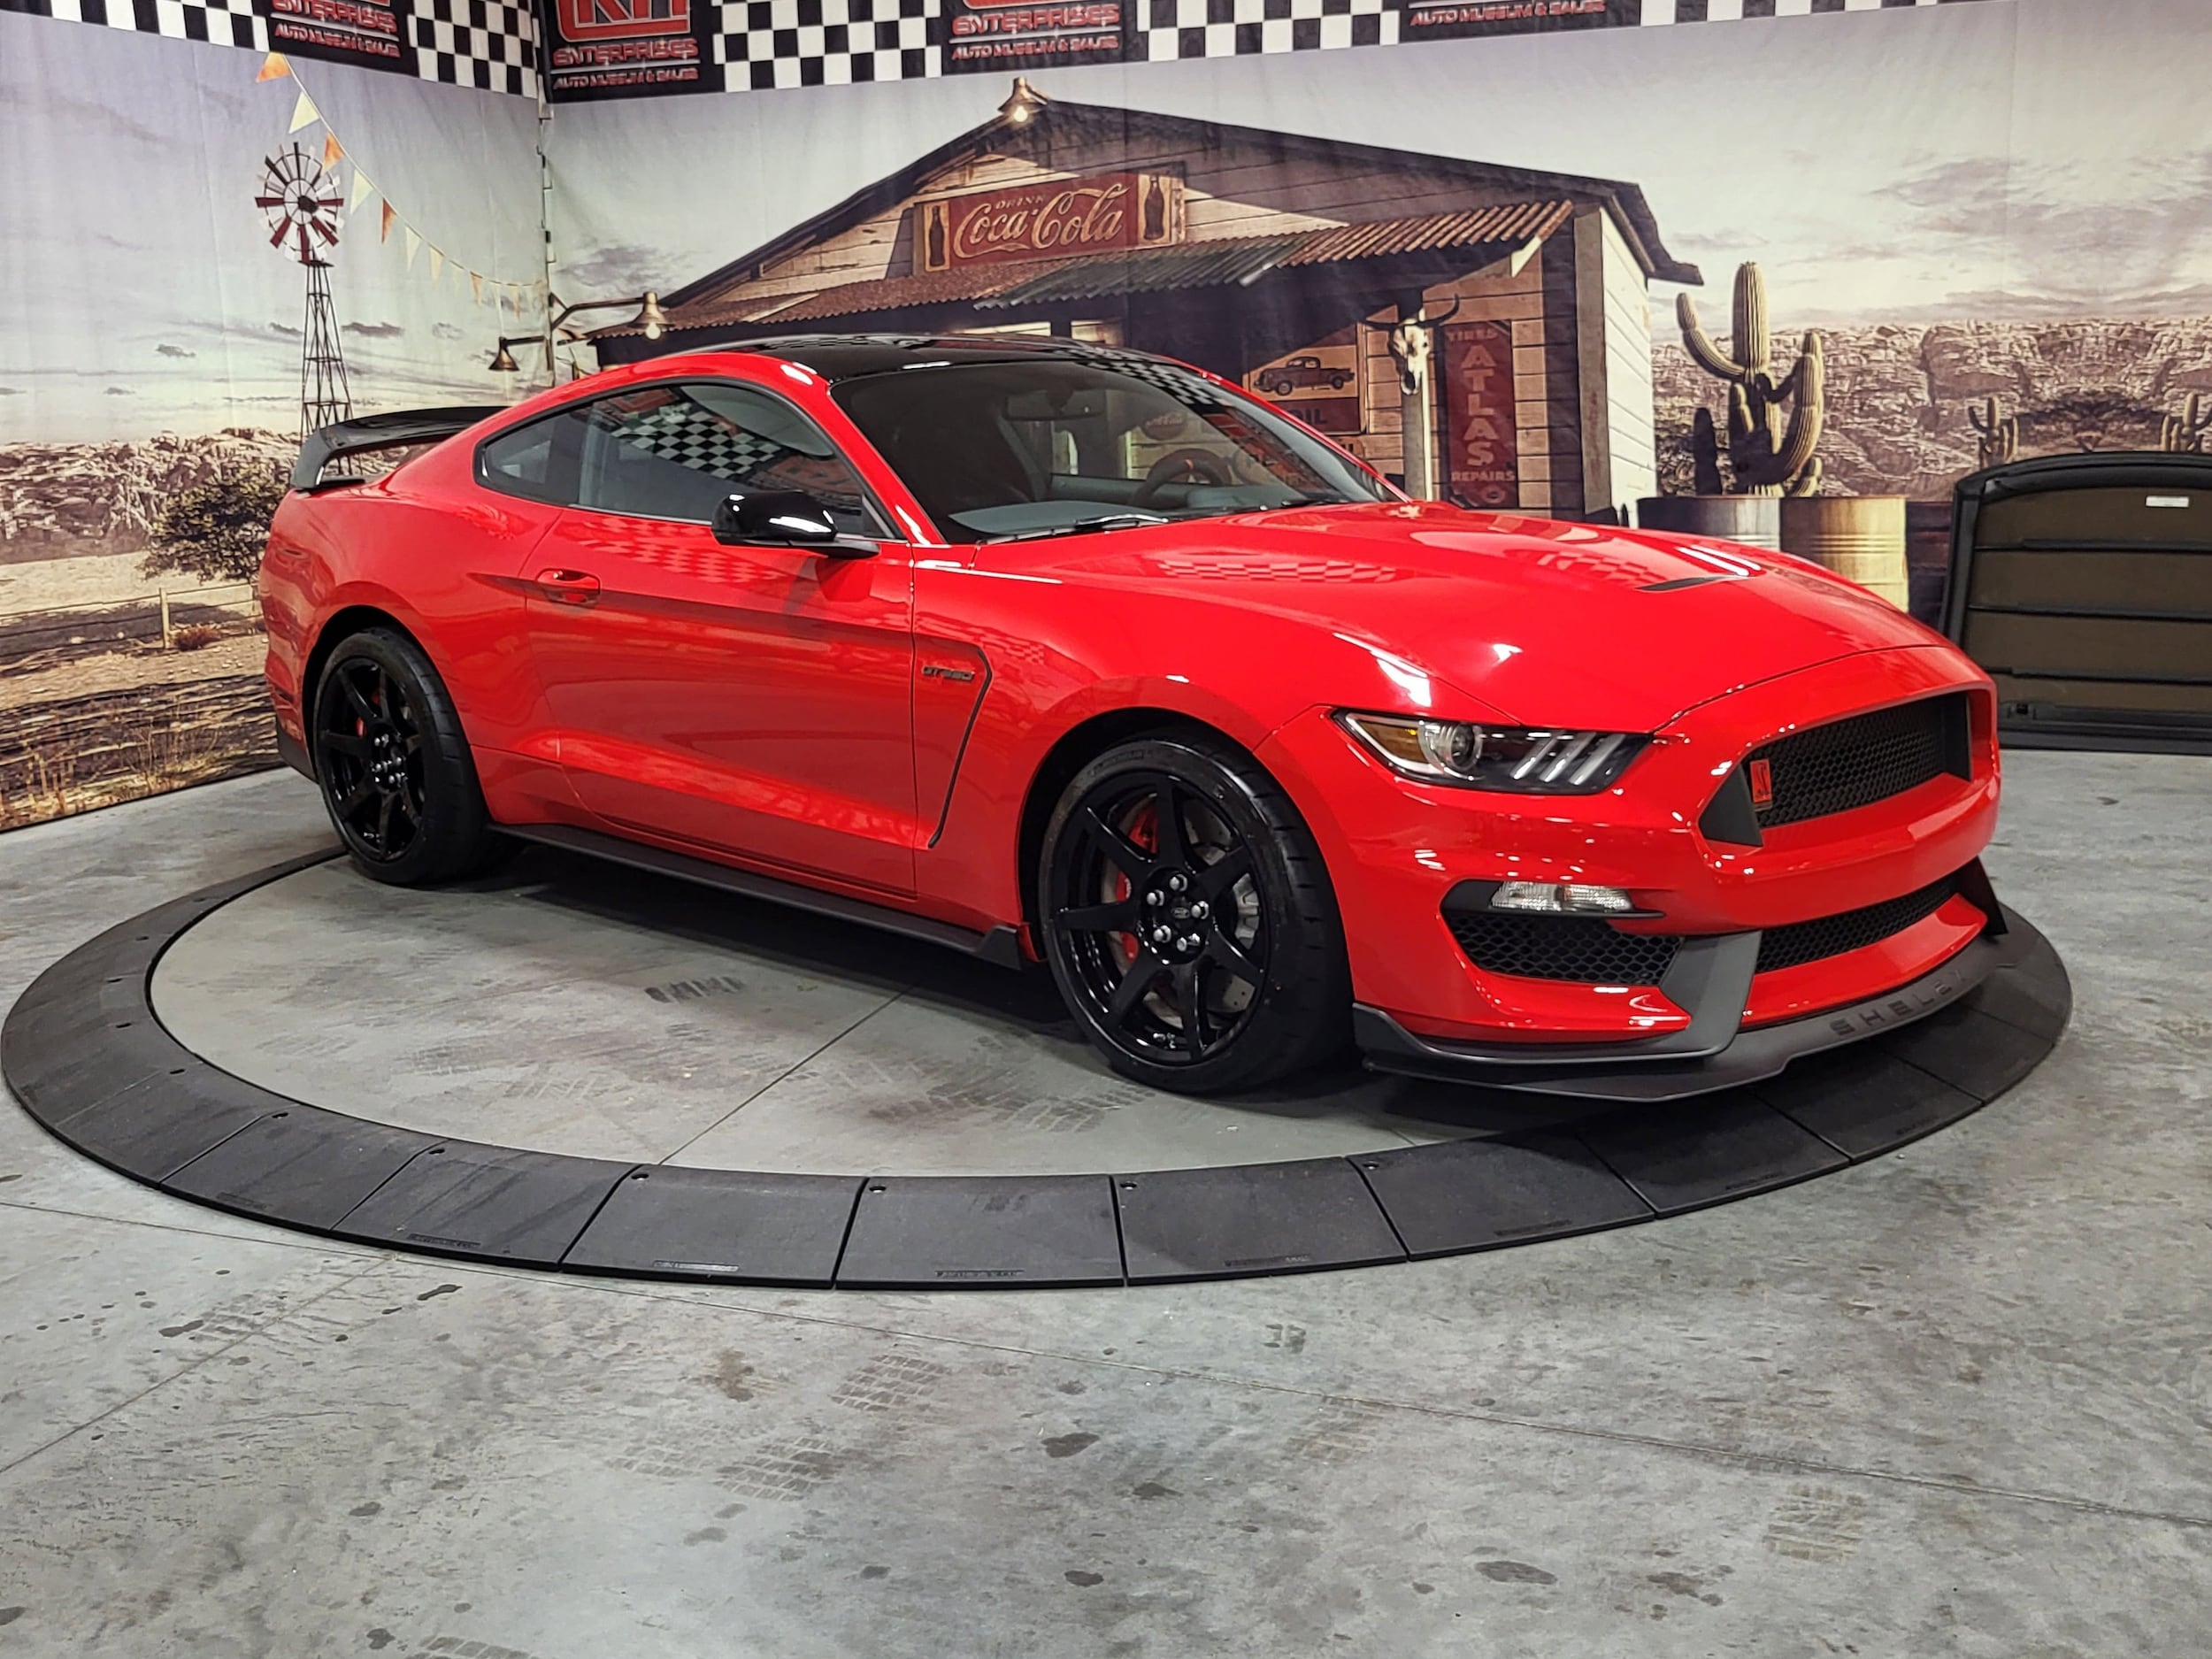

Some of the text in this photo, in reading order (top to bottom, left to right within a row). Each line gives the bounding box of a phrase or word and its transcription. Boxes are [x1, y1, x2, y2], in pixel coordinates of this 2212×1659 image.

[273, 0, 398, 34] ENTERPRISES
[951, 4, 1120, 35] ENTERPRISES
[1409, 10, 1458, 27] AUTO
[274, 23, 308, 42] AUTO
[553, 38, 699, 66] ENTERPRISES
[951, 45, 992, 60] AUTO
[553, 76, 589, 90] AUTO
[995, 193, 1046, 210] DRINK
[1461, 344, 1499, 467] ATLAS
[1450, 470, 1516, 482] REPAIRS
